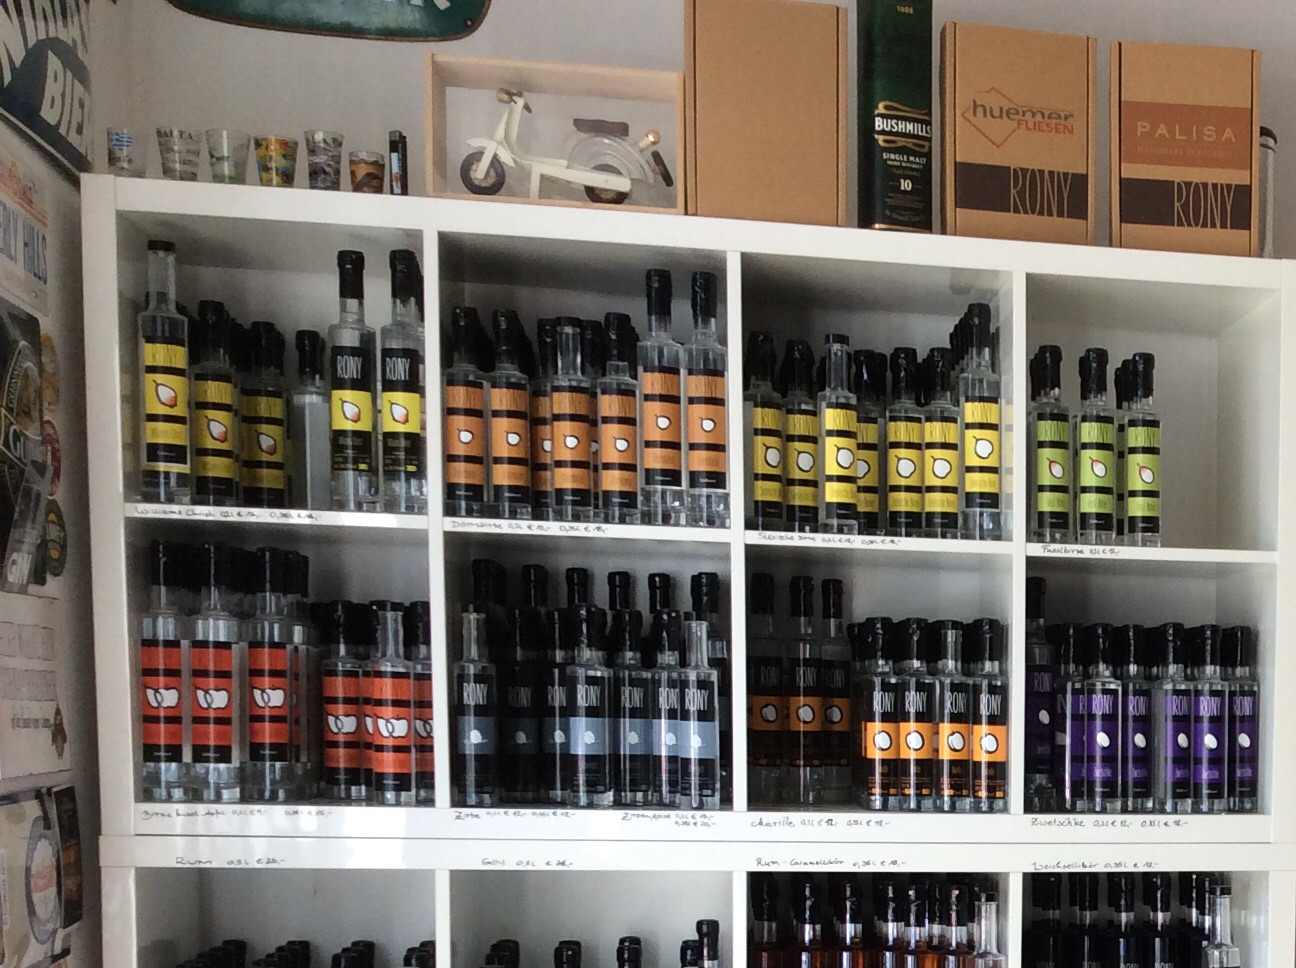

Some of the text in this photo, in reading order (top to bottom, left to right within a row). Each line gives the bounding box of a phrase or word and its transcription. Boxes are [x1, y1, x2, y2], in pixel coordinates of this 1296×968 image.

[973, 96, 1074, 122] huemer
[874, 115, 932, 138] BUSHMILLS
[1016, 117, 1074, 136] FLIESEN
[1136, 120, 1237, 144] PALISA
[882, 151, 927, 165] SINGLE MALT
[899, 178, 912, 191] 10
[1010, 167, 1073, 219] RONY
[1174, 181, 1236, 230] RONY
[337, 355, 362, 379] RONY
[386, 357, 411, 381] RONY
[463, 683, 488, 705] RONY
[577, 685, 601, 707] RONY
[621, 686, 644, 708] RONY
[684, 689, 709, 711] RONY
[873, 692, 895, 713] RONY
[905, 691, 927, 713] RONY
[980, 693, 1001, 716] RONY
[1092, 694, 1114, 715] RONY
[1200, 696, 1221, 717] RONY
